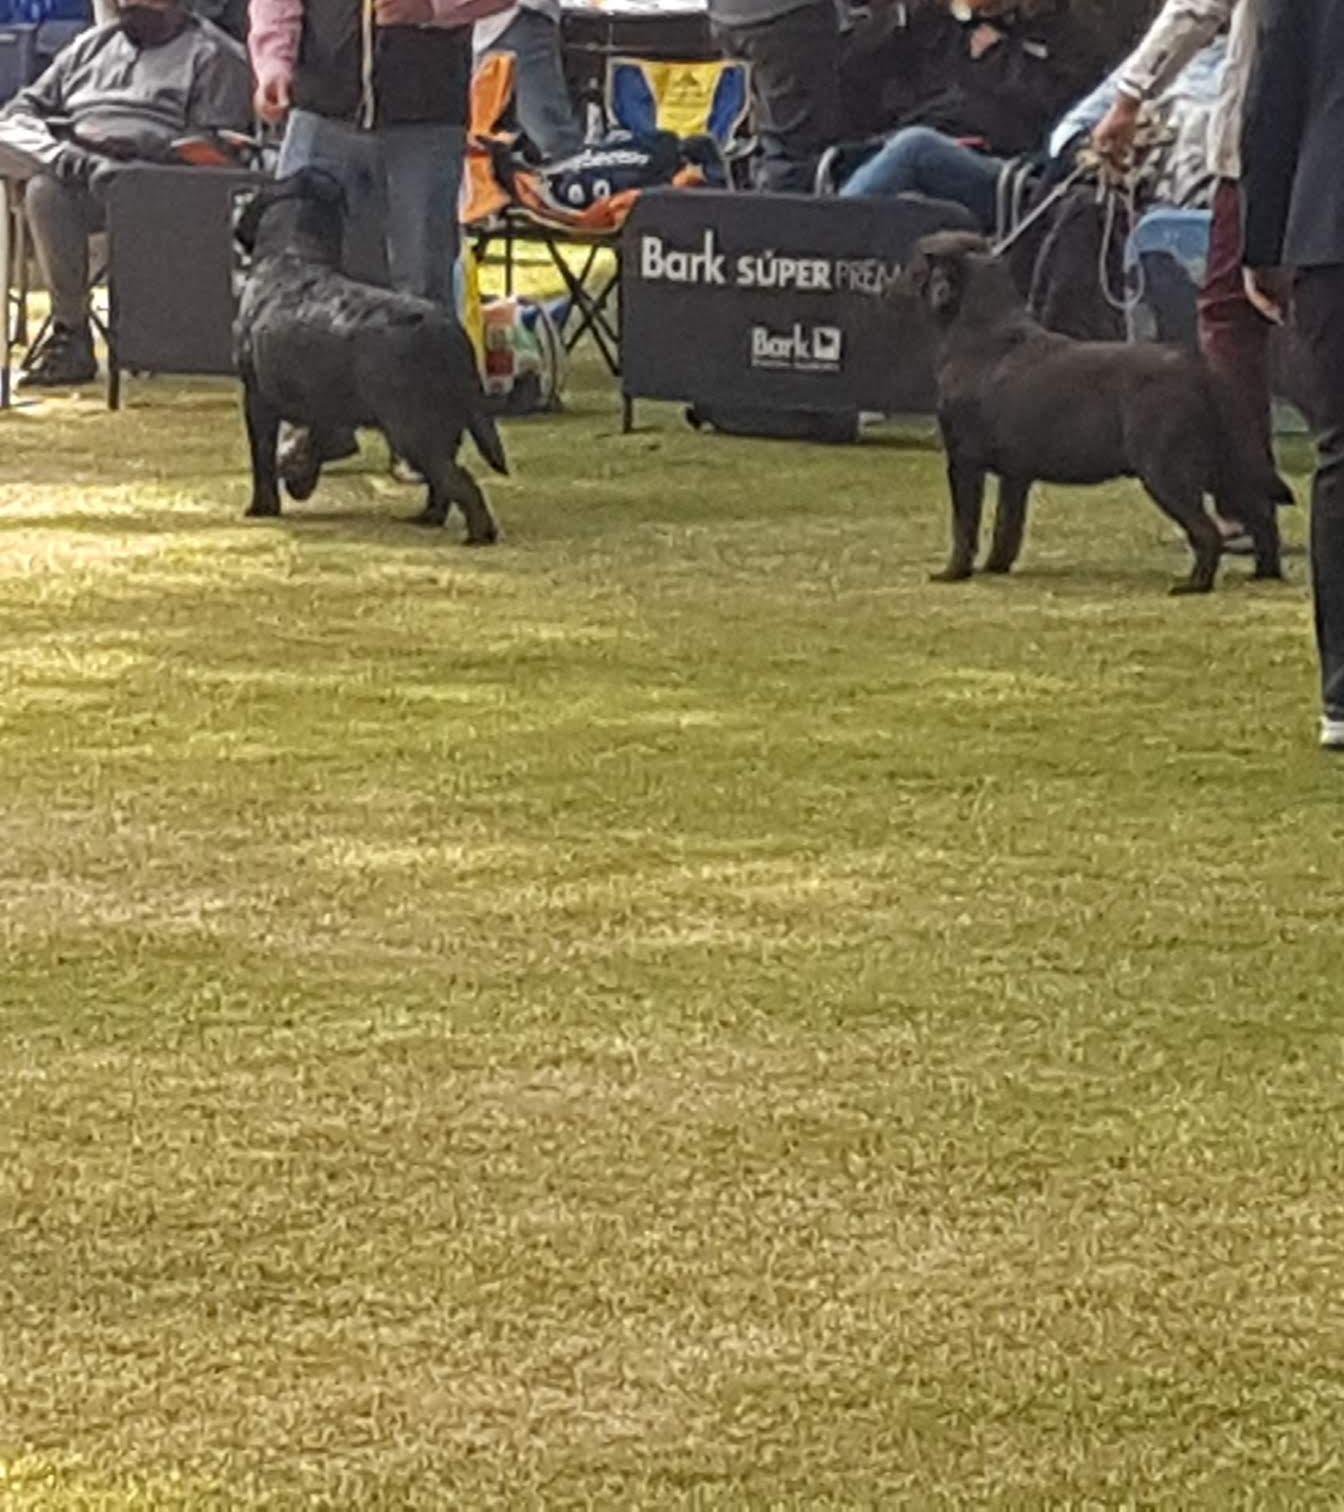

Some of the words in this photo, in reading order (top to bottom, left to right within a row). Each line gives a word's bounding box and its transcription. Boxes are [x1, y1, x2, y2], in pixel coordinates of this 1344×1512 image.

[641, 230, 726, 285] Bark
[736, 250, 832, 290] SÚPER
[752, 323, 811, 359] Bark
